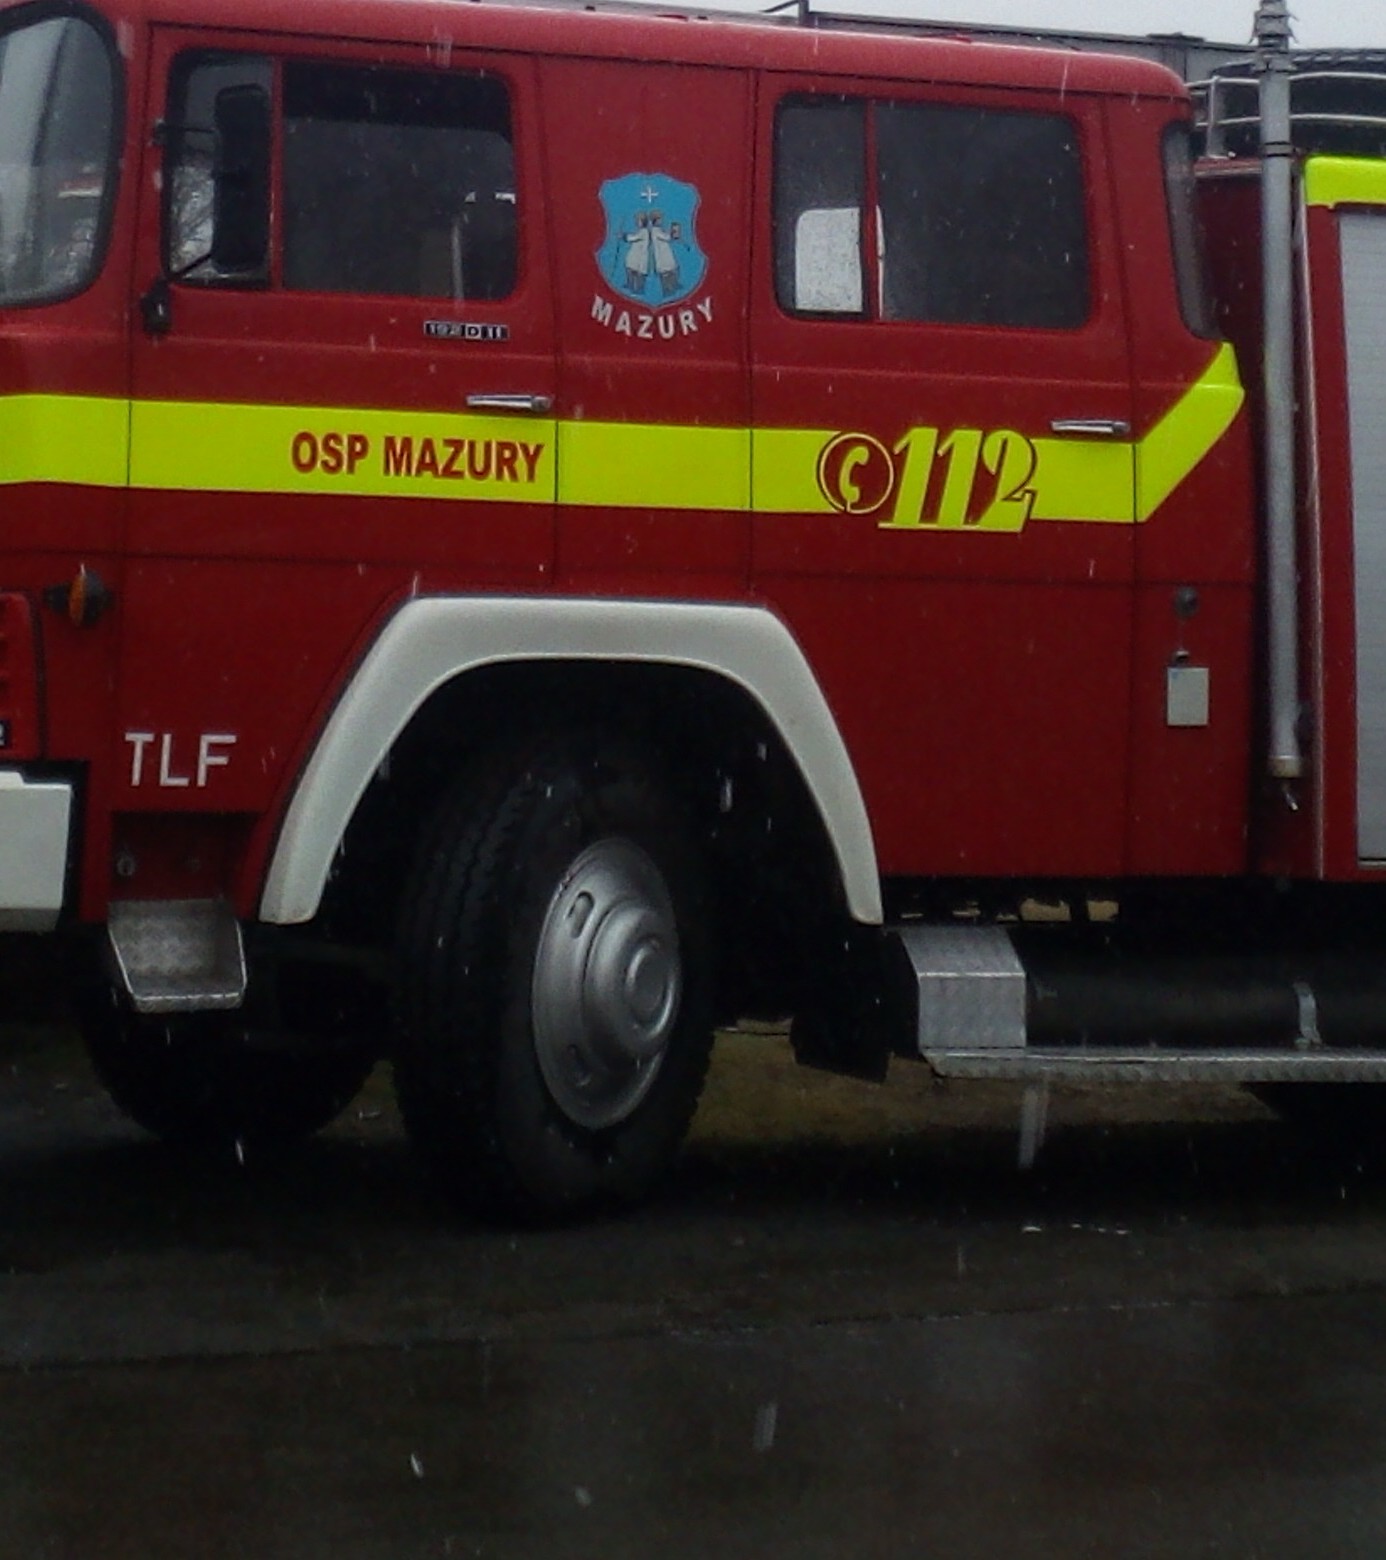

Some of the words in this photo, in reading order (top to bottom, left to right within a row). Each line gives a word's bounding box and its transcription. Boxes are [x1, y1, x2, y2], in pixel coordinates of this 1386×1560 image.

[591, 293, 714, 340] MAZURY
[291, 431, 369, 476] OSP
[383, 435, 545, 483] MAZURY
[878, 426, 1038, 533] 112
[124, 731, 237, 787] TLF
